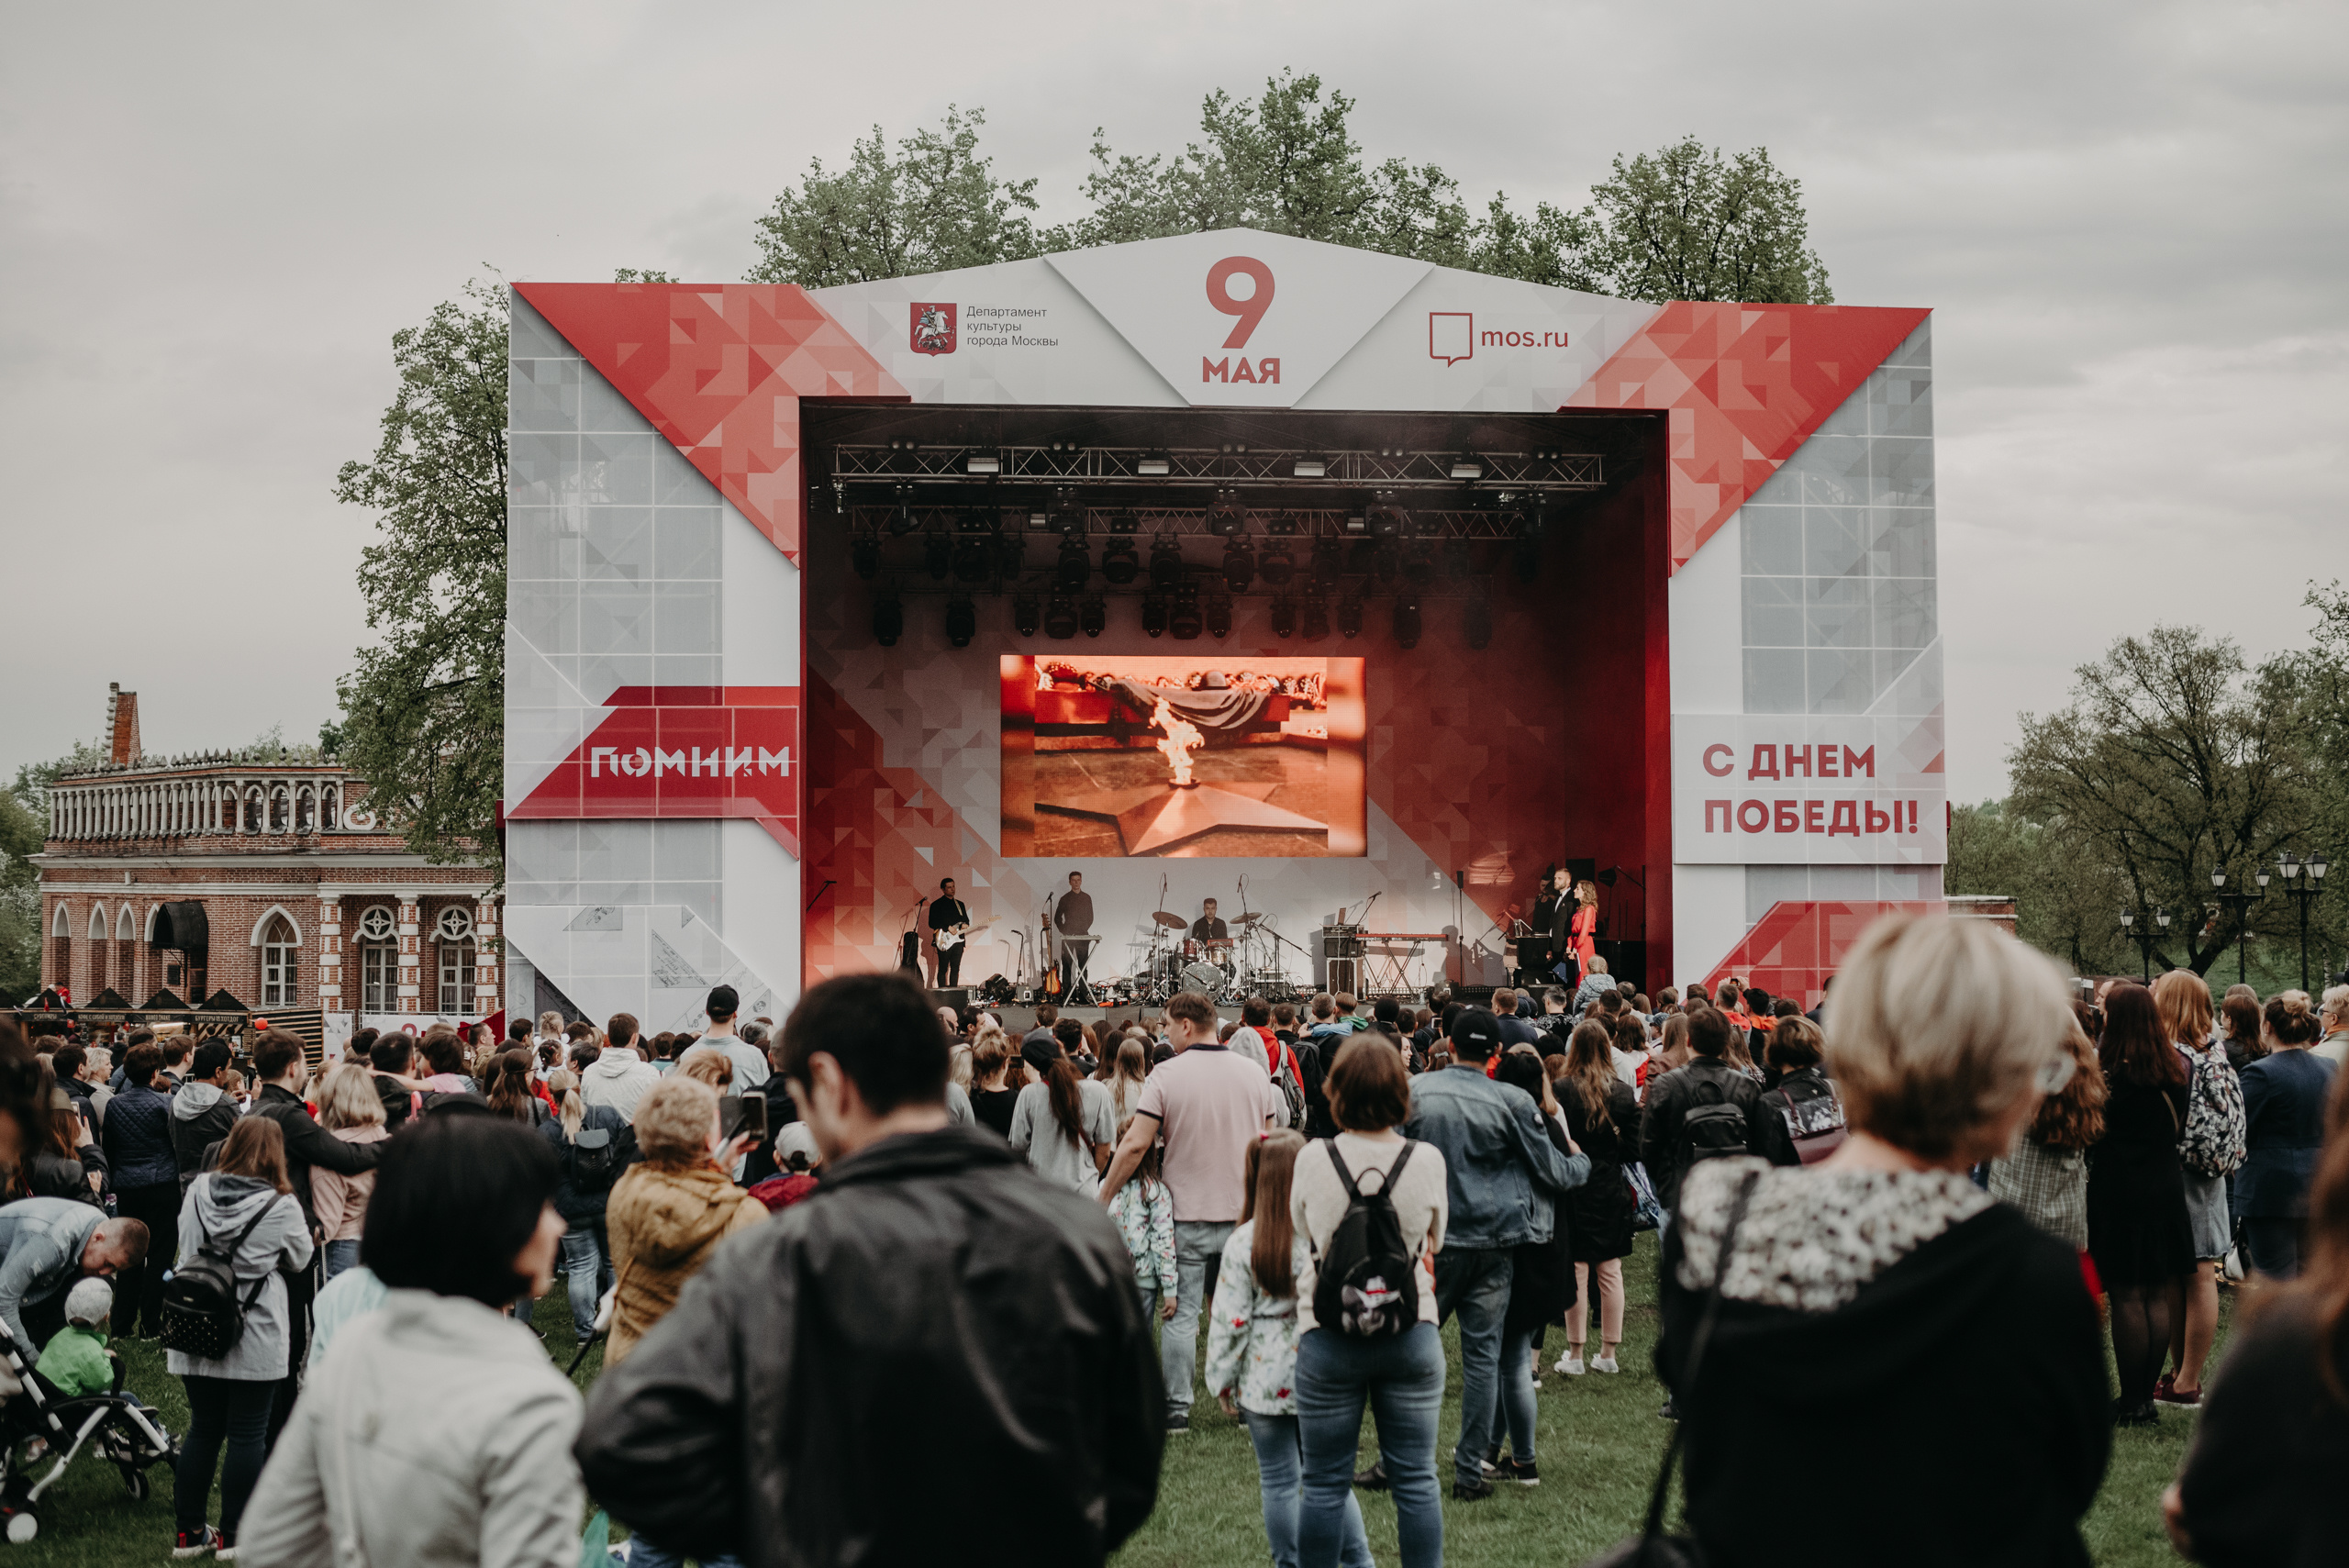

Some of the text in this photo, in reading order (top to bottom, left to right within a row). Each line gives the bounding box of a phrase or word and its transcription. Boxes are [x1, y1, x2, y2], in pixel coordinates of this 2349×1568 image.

[966, 306, 1047, 318] Департамент
[1206, 256, 1275, 349] 9
[966, 322, 1022, 333] культуры
[1481, 330, 1569, 348] mos.ru
[966, 336, 1059, 348] города Москвы
[1202, 356, 1281, 384] МАЯ
[591, 746, 789, 778] ПОМНИМ
[1702, 743, 1875, 781] С ДНЕМ
[1705, 799, 1919, 837] ПОБЕДЫ!
